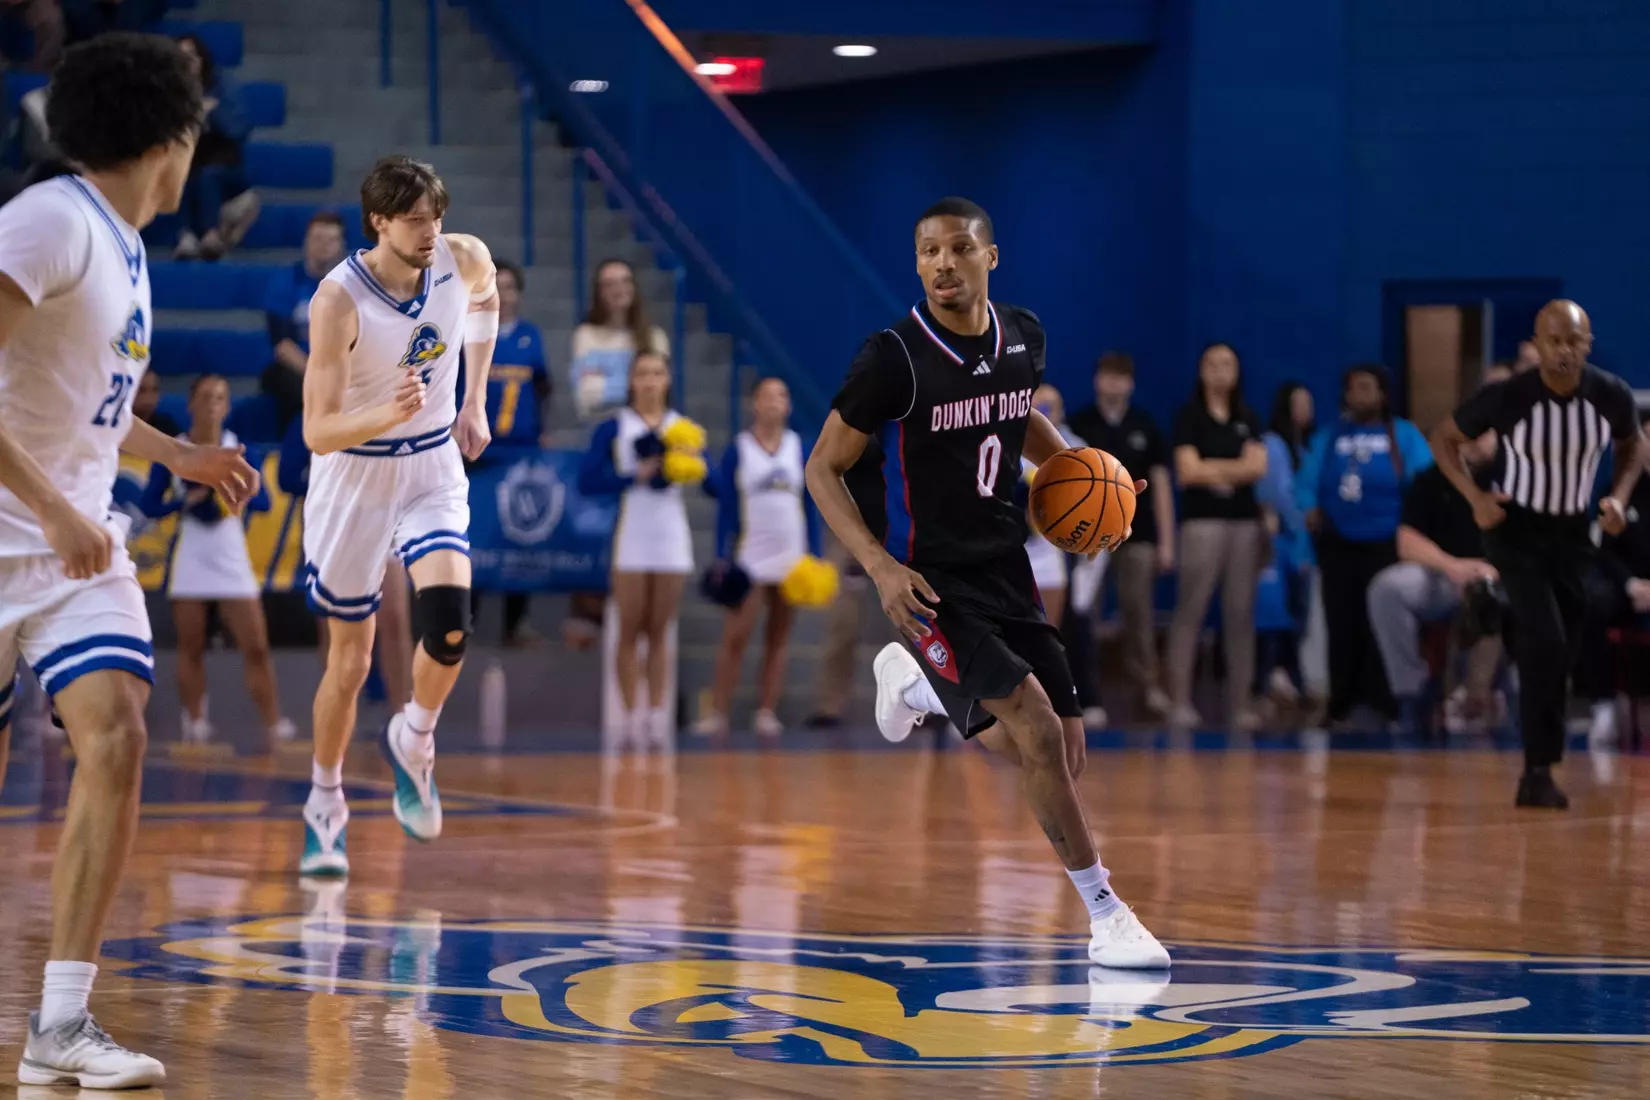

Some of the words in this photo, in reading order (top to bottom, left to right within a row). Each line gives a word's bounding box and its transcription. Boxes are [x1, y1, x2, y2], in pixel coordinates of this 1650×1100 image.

[91, 373, 133, 428] 21
[931, 394, 994, 432] DUNKIN'
[998, 388, 1032, 421] DOGS
[977, 433, 1002, 497] 0
